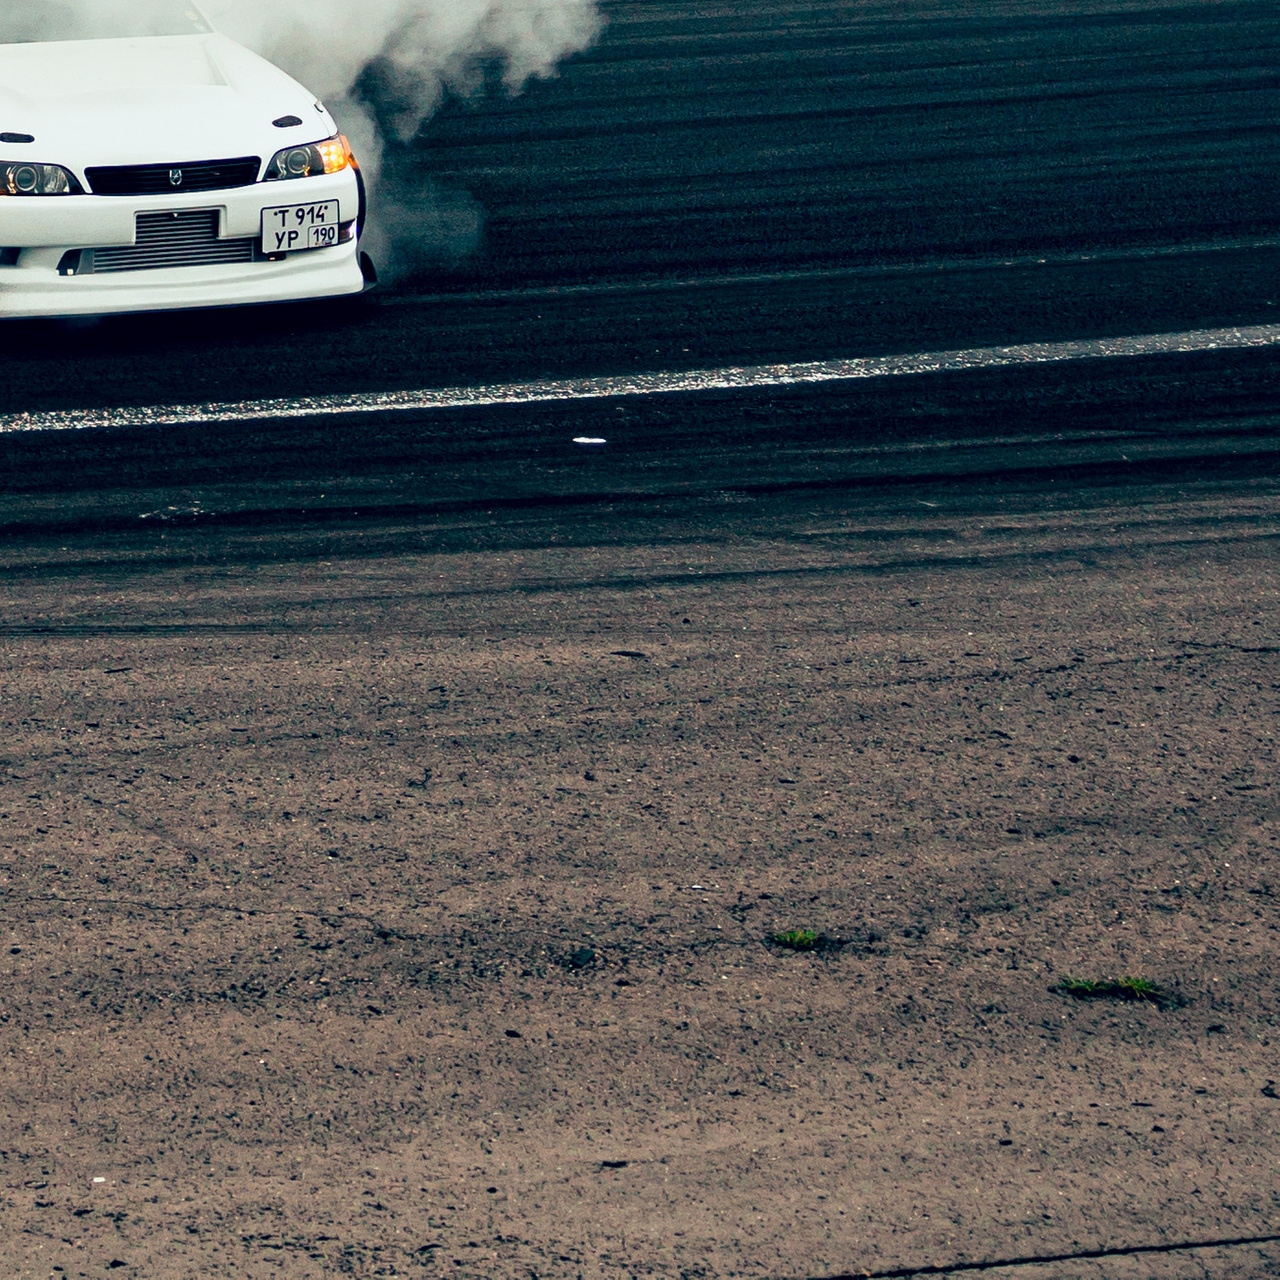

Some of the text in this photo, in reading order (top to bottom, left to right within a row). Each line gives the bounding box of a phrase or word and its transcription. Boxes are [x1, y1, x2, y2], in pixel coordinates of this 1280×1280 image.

[278, 205, 325, 227] Т 914
[275, 226, 335, 249] УР 190
